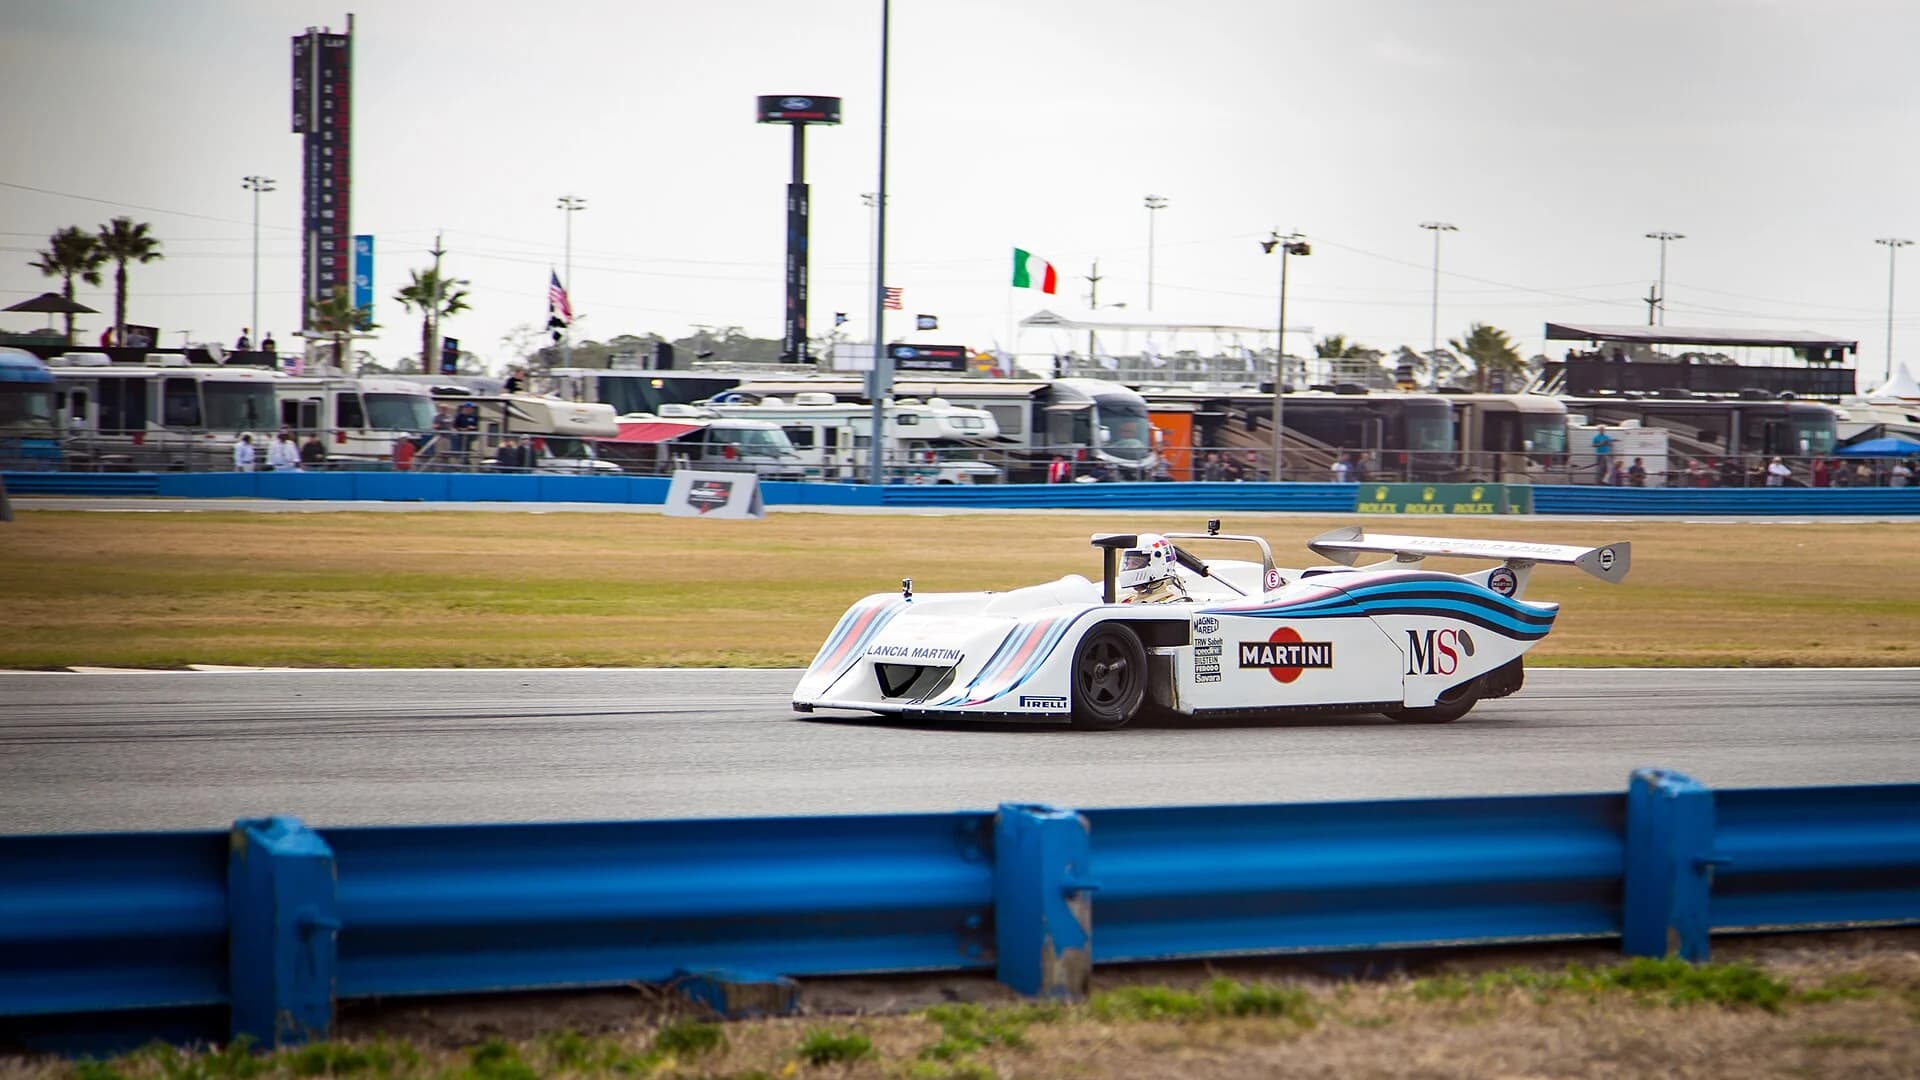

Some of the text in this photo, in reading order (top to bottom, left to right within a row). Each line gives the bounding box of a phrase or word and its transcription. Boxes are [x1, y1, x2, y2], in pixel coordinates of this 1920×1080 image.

[1357, 503, 1397, 513] ROLEX
[1404, 503, 1445, 513] ROLEX
[1452, 503, 1494, 513] ROLEX
[1195, 638, 1206, 646] TRW
[867, 645, 961, 660] LANCIA MARTINI
[1242, 645, 1329, 665] MARTINI
[1020, 695, 1067, 708] PIRELLI
